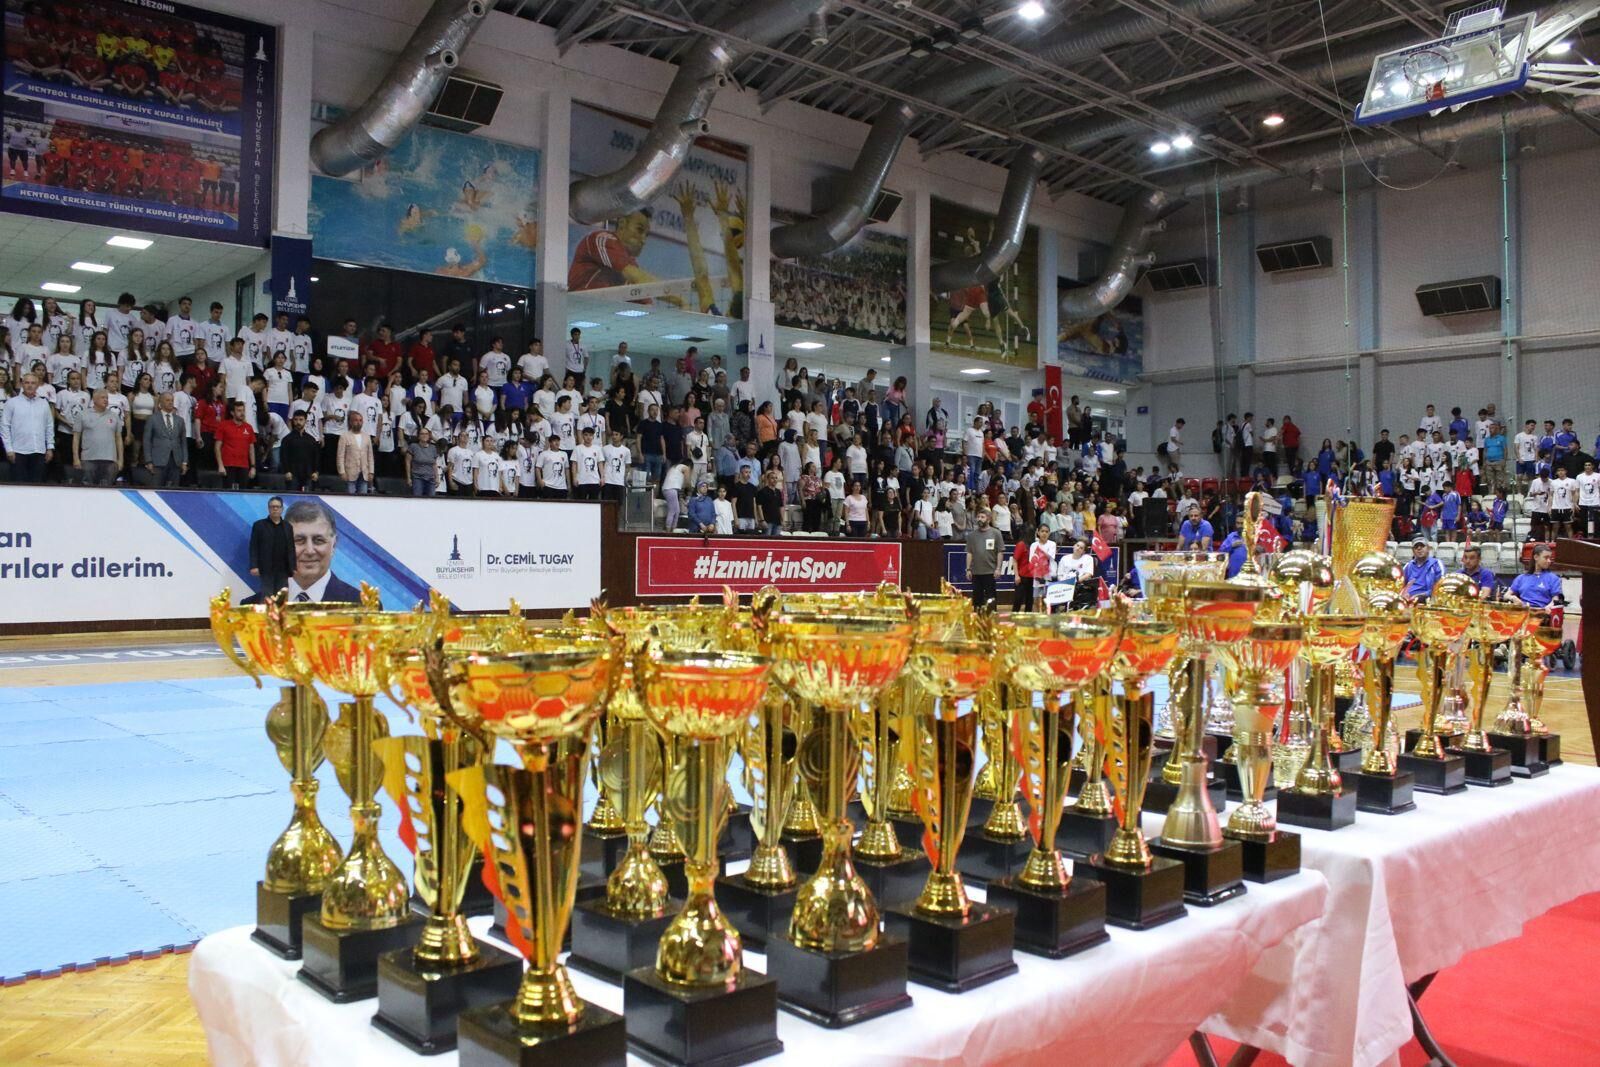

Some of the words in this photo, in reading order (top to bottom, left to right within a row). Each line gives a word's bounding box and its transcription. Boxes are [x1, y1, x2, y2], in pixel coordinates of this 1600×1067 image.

[28, 85, 68, 98] HENTBOL
[71, 93, 114, 107] KADINLAR
[116, 101, 152, 115] TÜRKİYE
[154, 110, 183, 121] KUPASI
[20, 189, 60, 201] HENTBOL
[62, 195, 106, 208] ERKEKLER
[109, 202, 144, 214] TÜRKİYE
[146, 208, 175, 218] KUPASI
[178, 212, 224, 225] ŞAMPİYONU
[1, 557, 64, 579] rılar
[71, 556, 174, 578] dilerim.
[487, 554, 501, 565] Dr.
[504, 551, 537, 565] CEMİL
[539, 554, 574, 565] TUGAY
[694, 550, 847, 582] #İzmirİçinSpor
